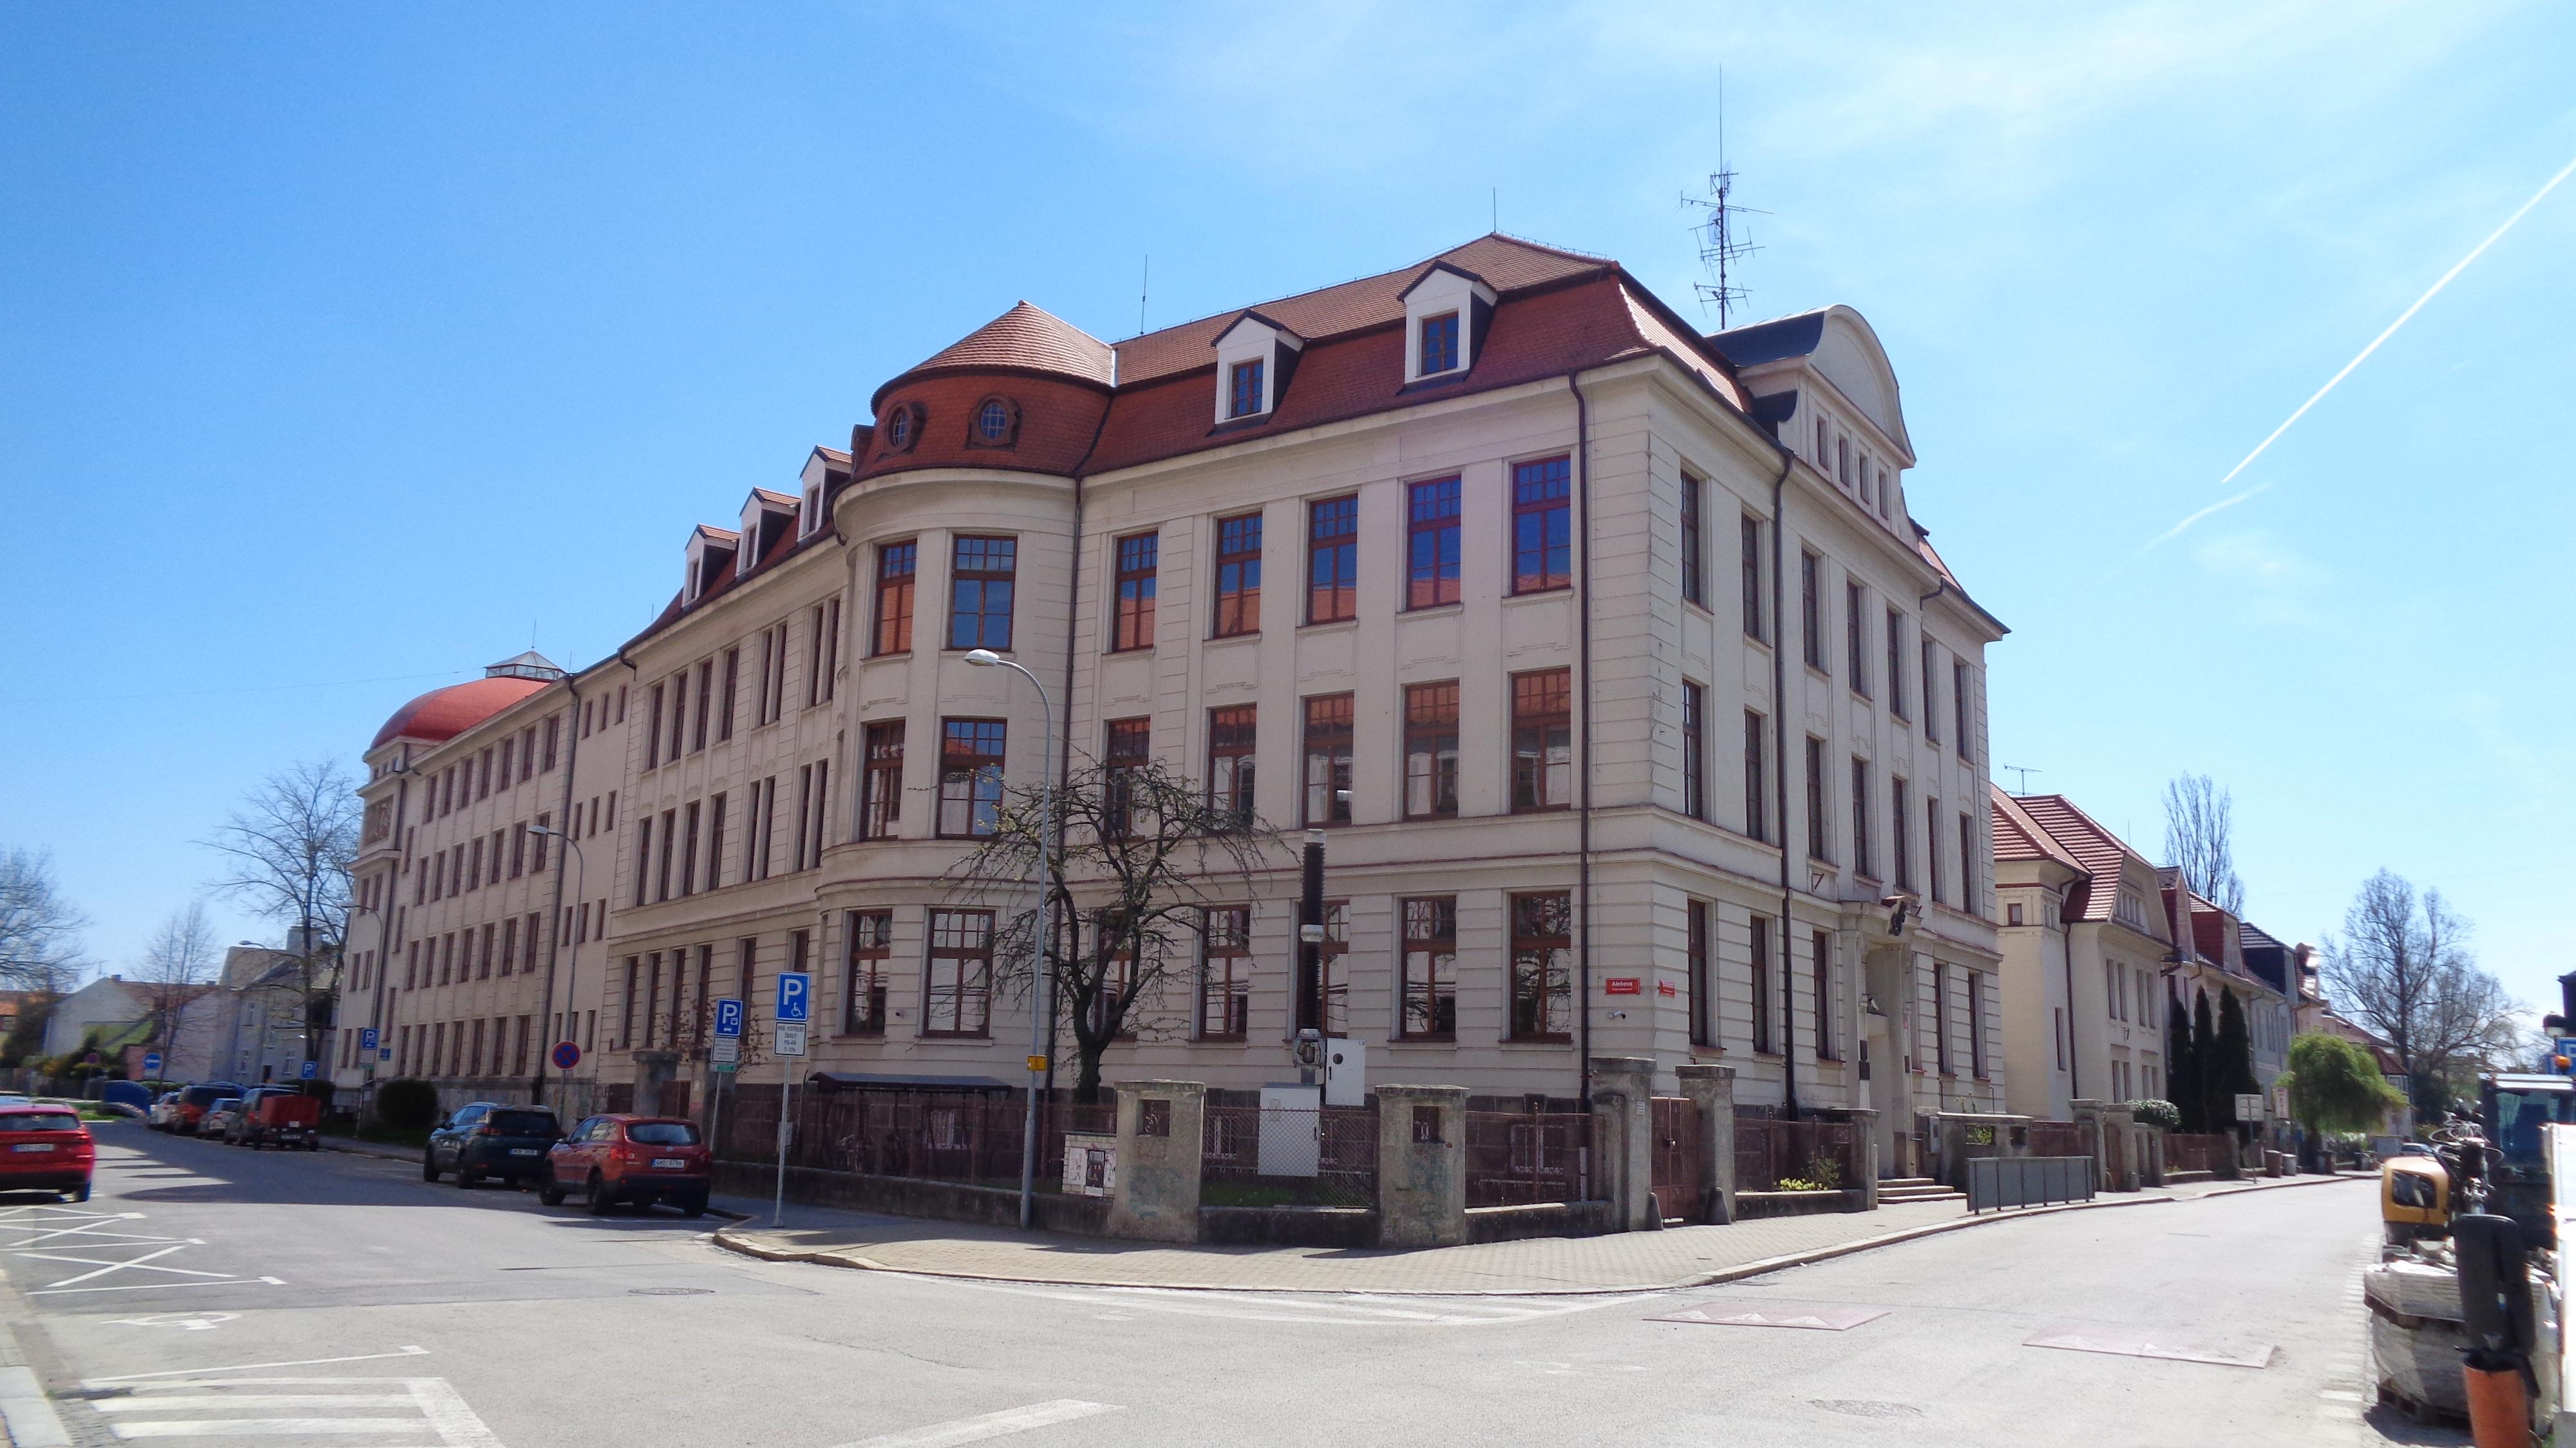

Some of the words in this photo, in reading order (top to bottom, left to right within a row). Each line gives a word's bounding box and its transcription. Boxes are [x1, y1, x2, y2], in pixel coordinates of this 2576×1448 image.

[784, 979, 802, 1005] P
[723, 1004, 737, 1024] P
[366, 1031, 375, 1042] P
[304, 1064, 313, 1074] P
